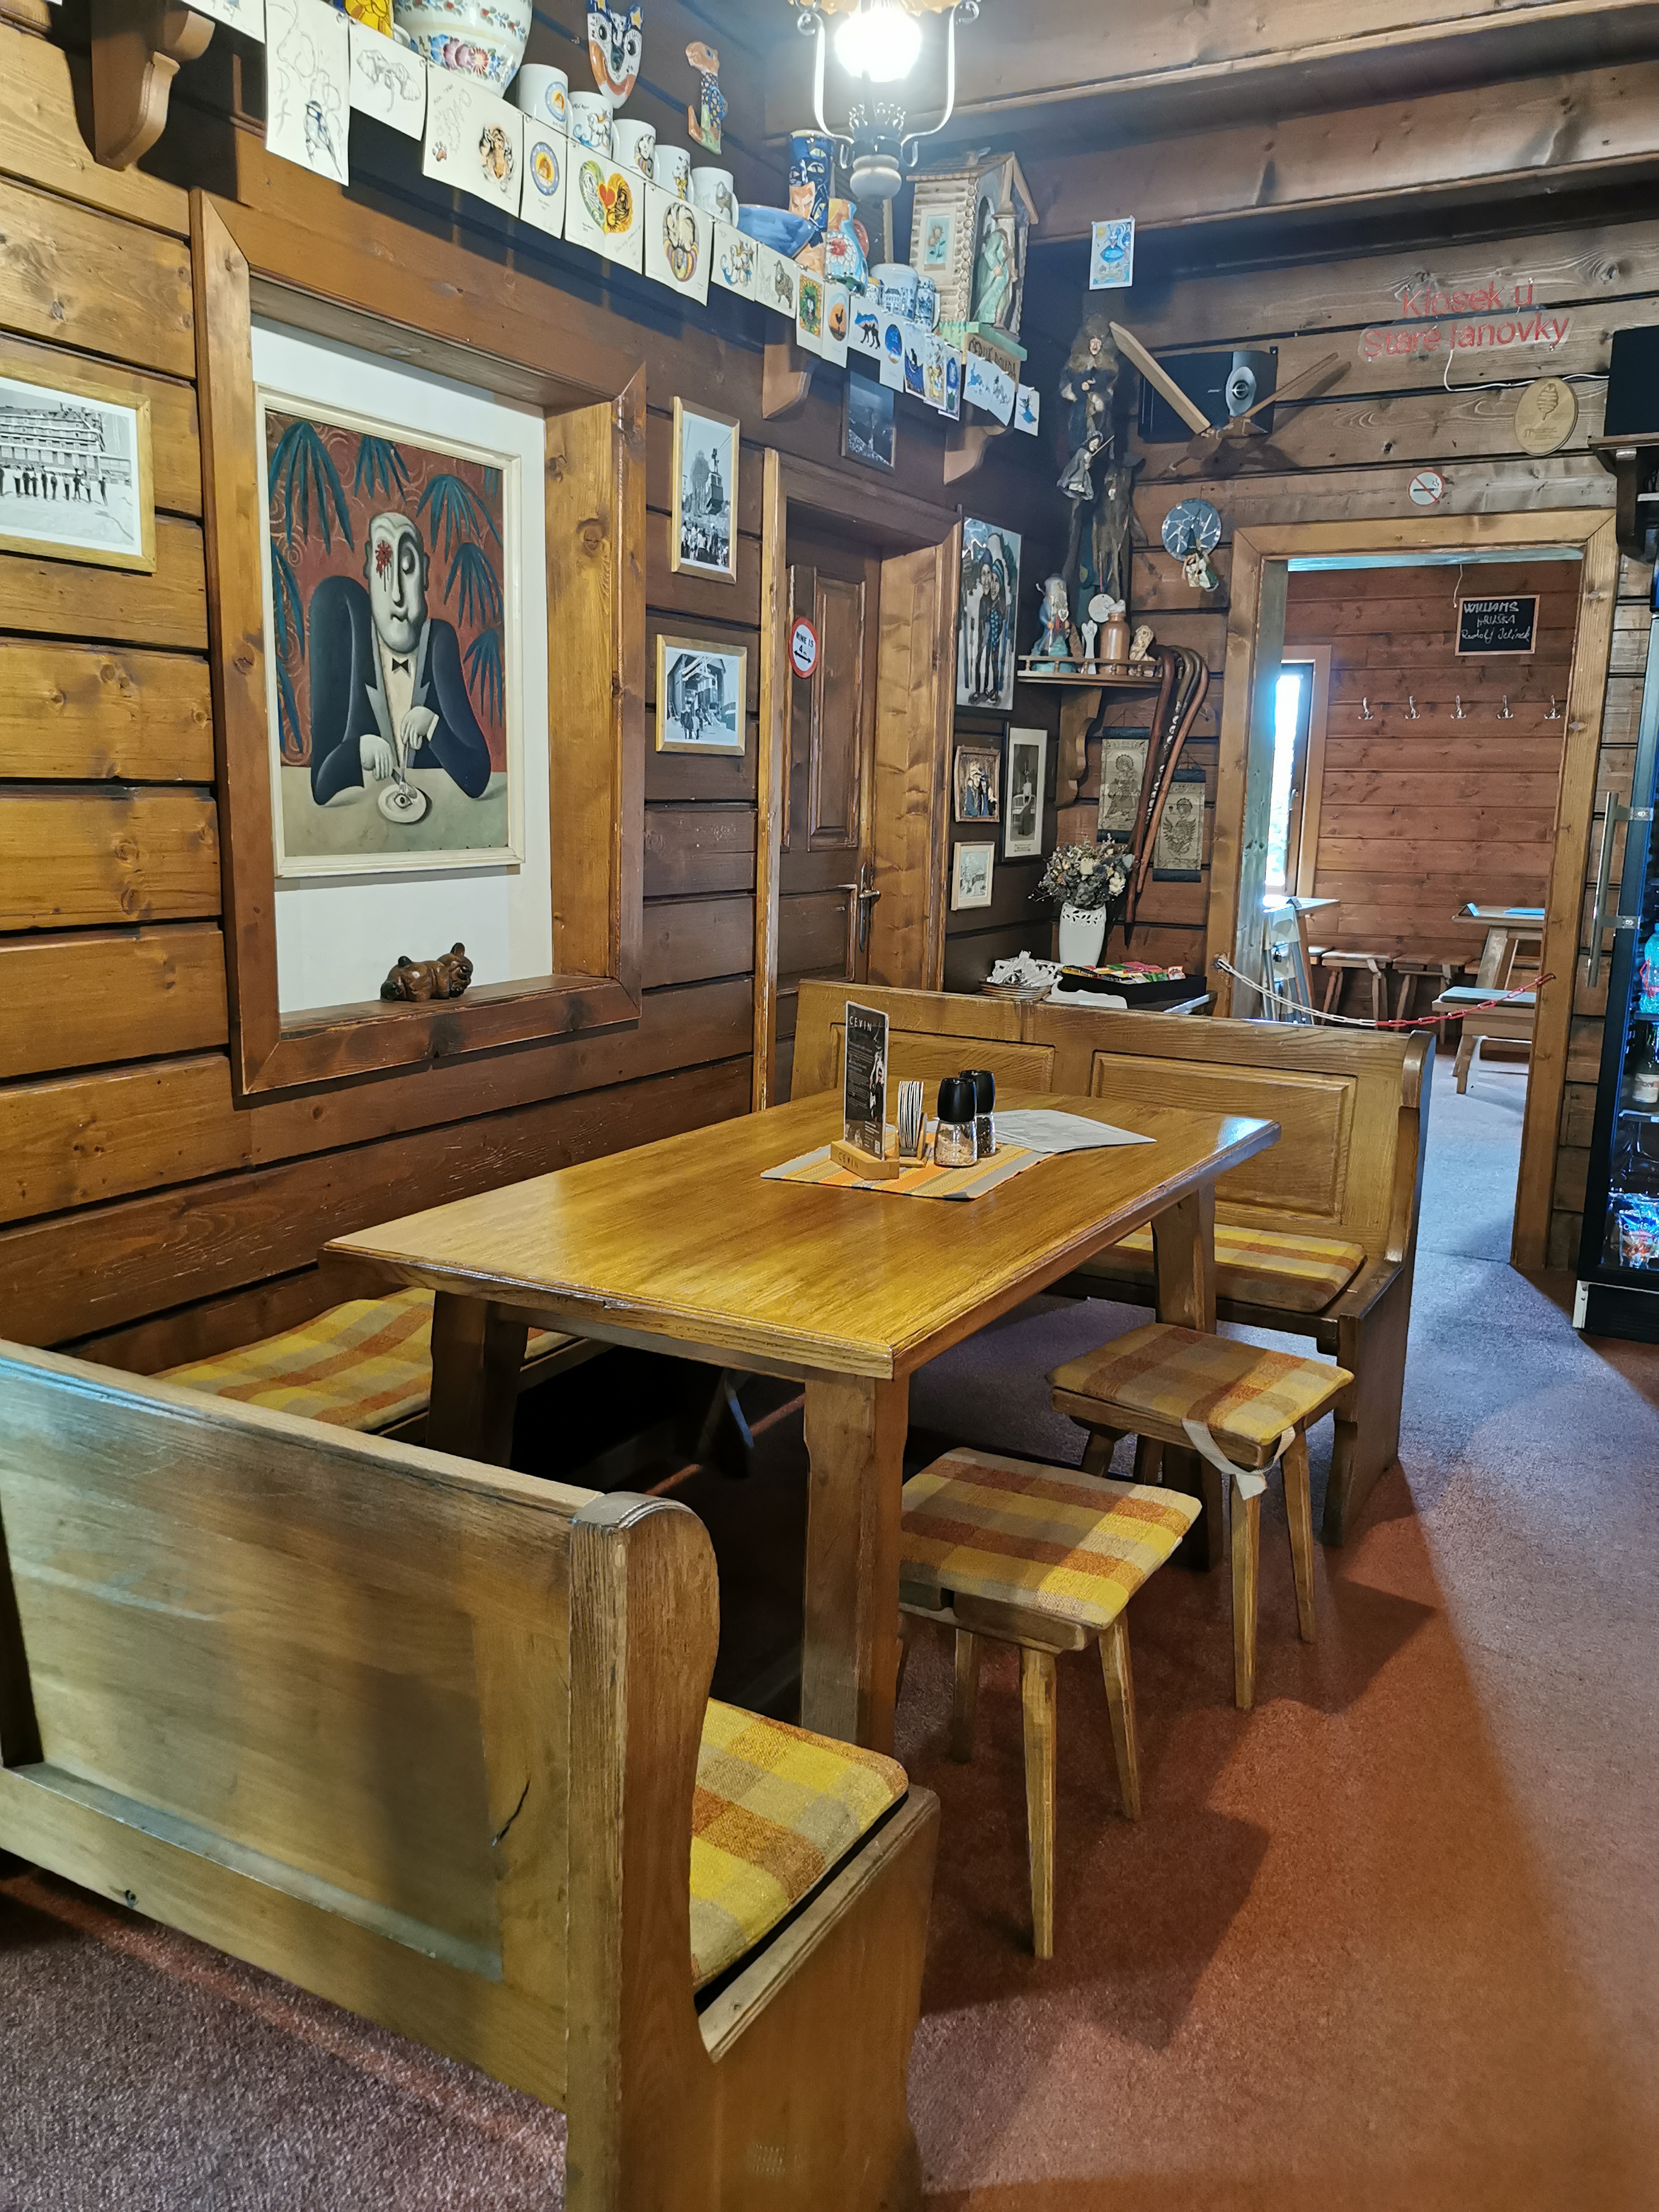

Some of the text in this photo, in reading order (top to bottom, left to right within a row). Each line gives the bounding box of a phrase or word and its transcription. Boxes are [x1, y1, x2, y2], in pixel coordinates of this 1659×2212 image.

[1515, 283, 1533, 306] u
[1464, 601, 1520, 613] WILLIAMS
[1461, 627, 1495, 645] Rudolf
